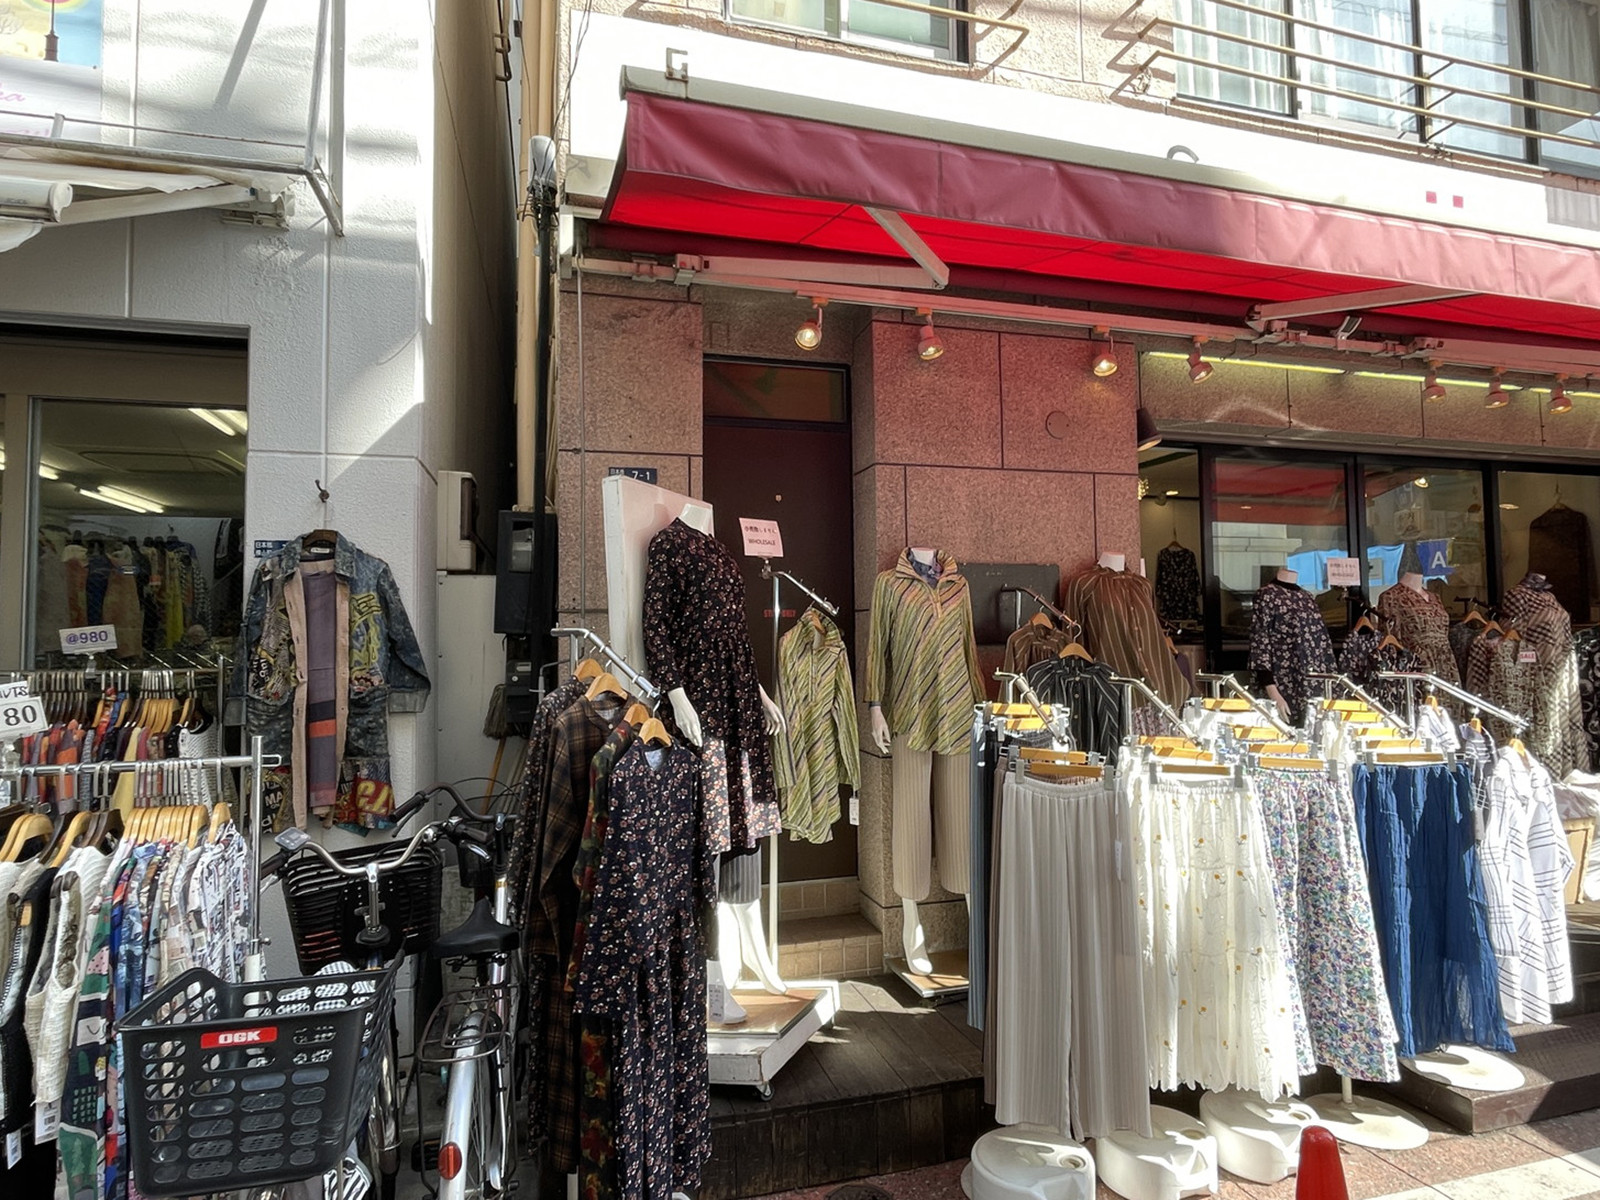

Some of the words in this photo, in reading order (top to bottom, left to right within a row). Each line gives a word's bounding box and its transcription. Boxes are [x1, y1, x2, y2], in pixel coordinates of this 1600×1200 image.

[632, 470, 650, 481] 7-1
[1431, 551, 1447, 569] A
[65, 630, 108, 646] @980
[3, 705, 37, 727] 80
[218, 1030, 261, 1045] OGK
